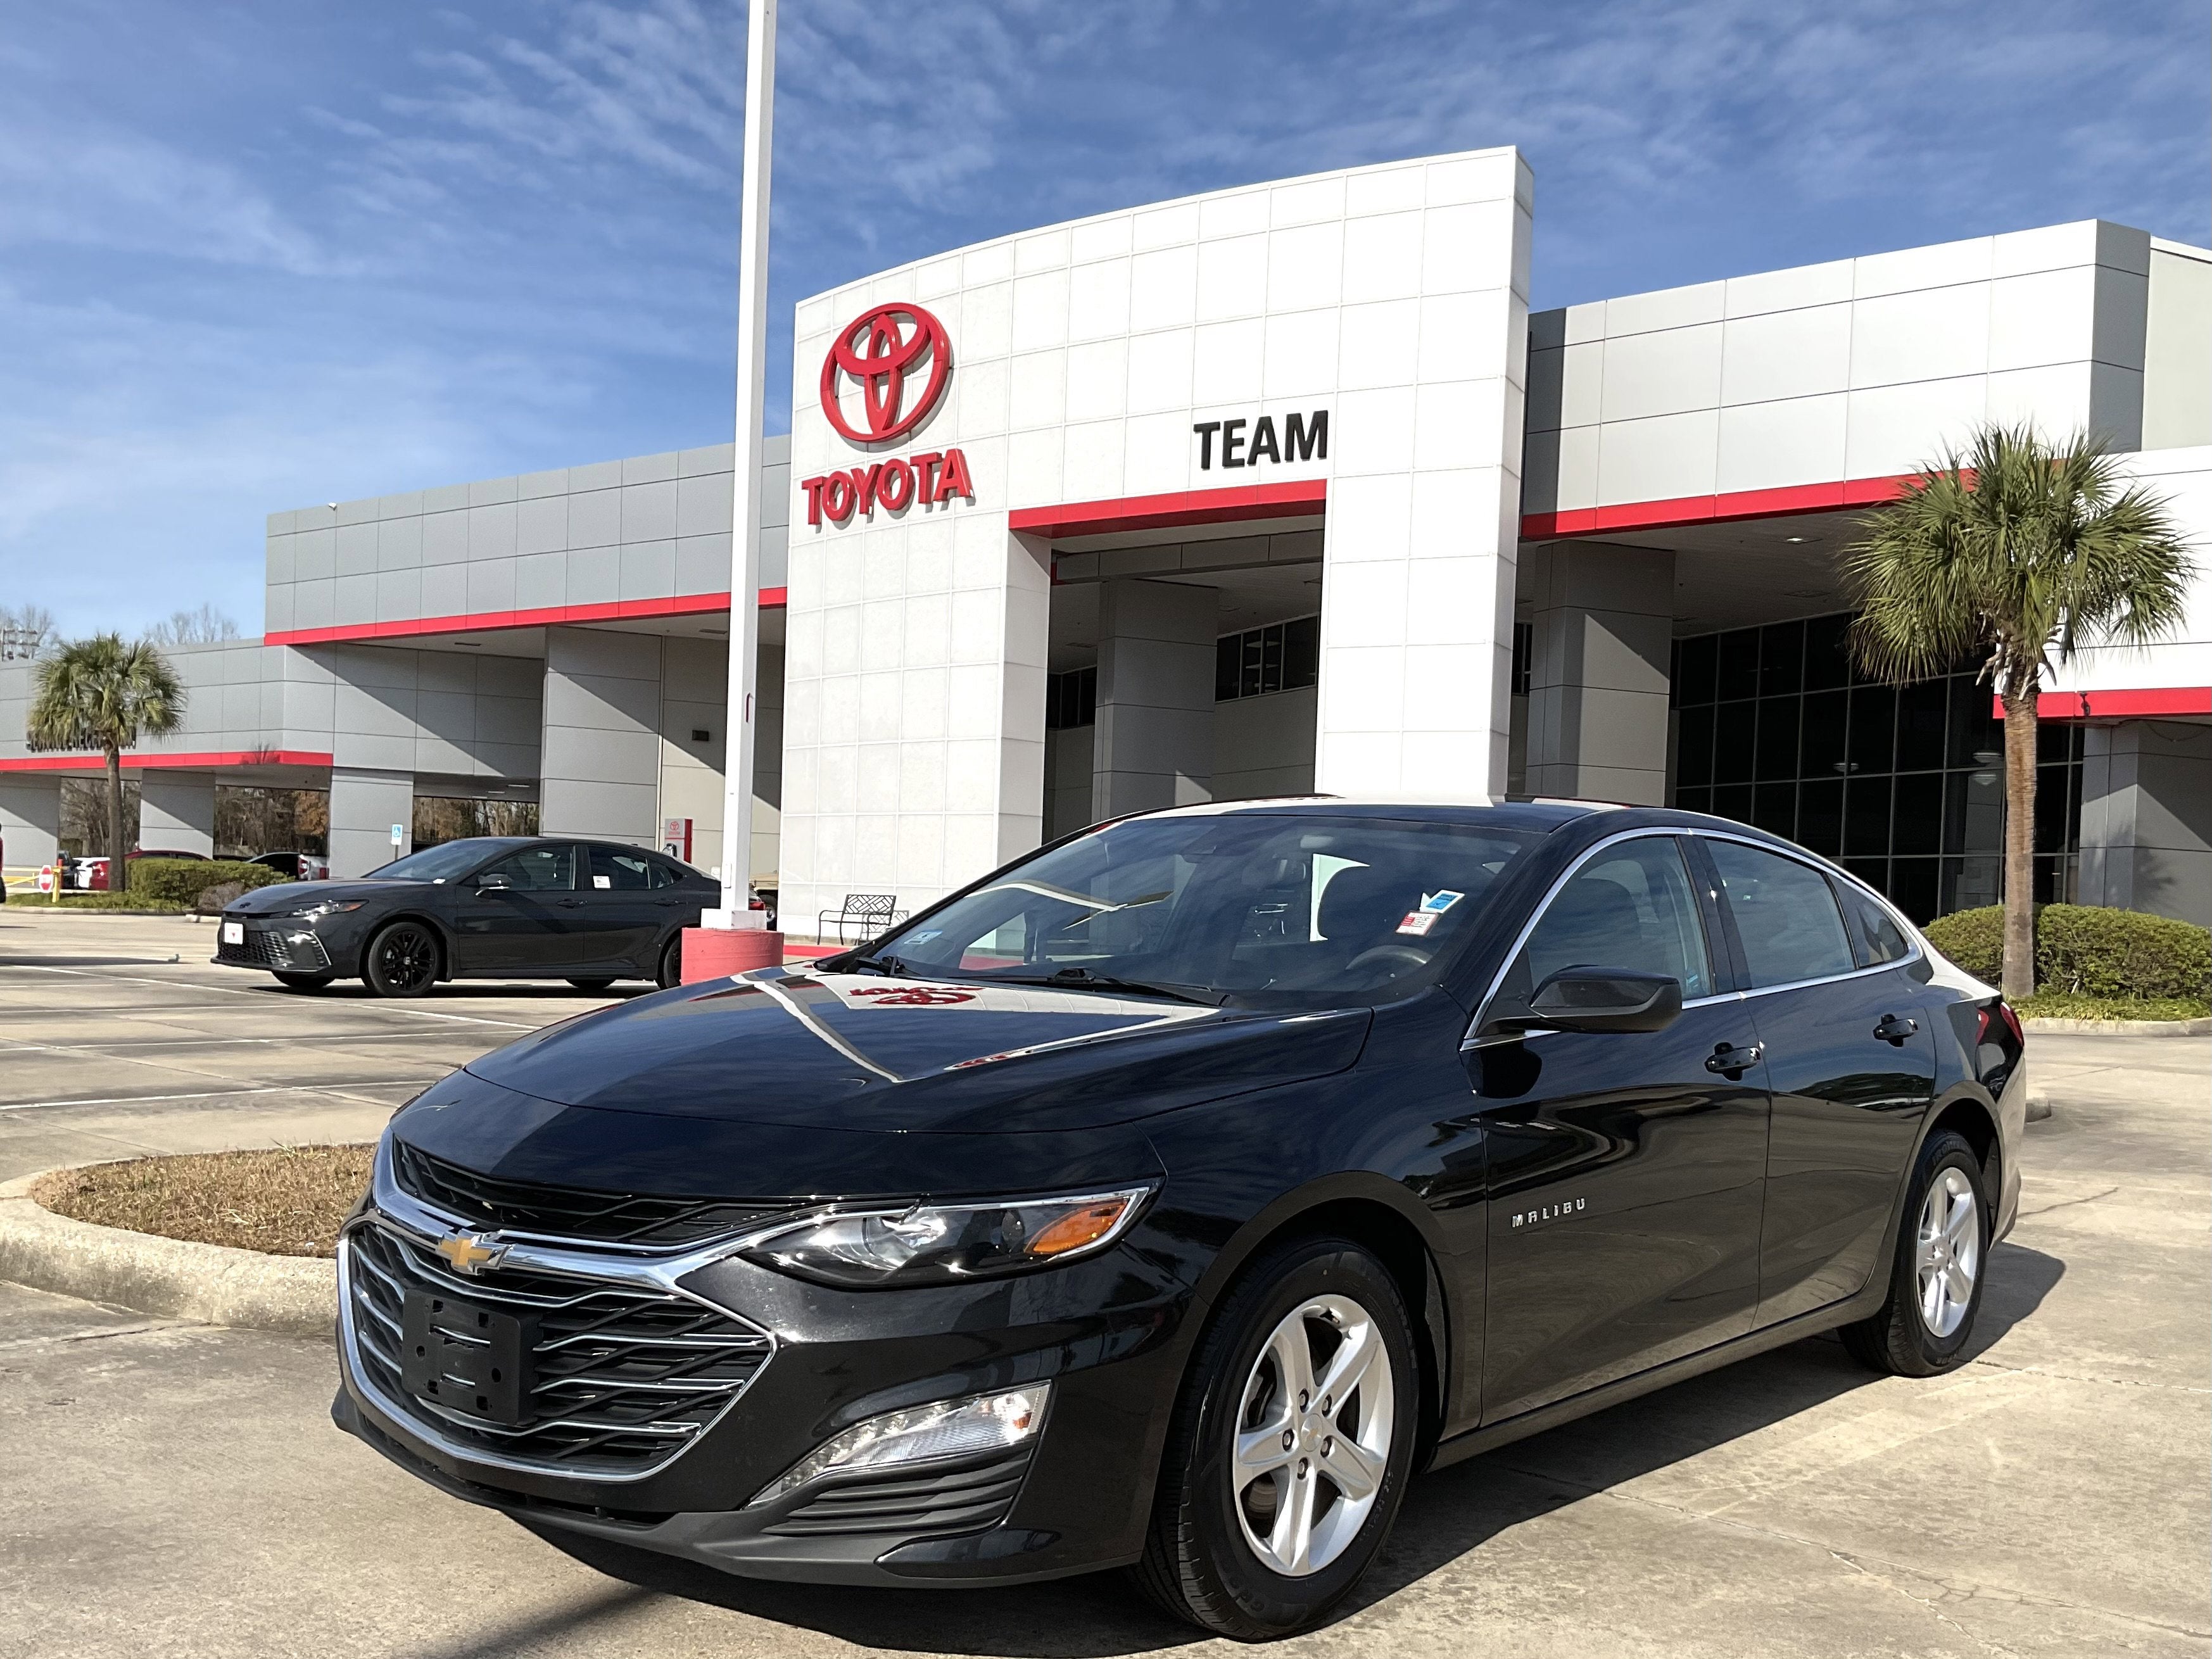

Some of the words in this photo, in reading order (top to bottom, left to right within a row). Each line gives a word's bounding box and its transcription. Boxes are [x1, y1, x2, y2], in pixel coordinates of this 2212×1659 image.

[1193, 410, 1329, 470] TEAM
[801, 448, 975, 526] TOYOTA
[1512, 1198, 1585, 1228] MALIBU
